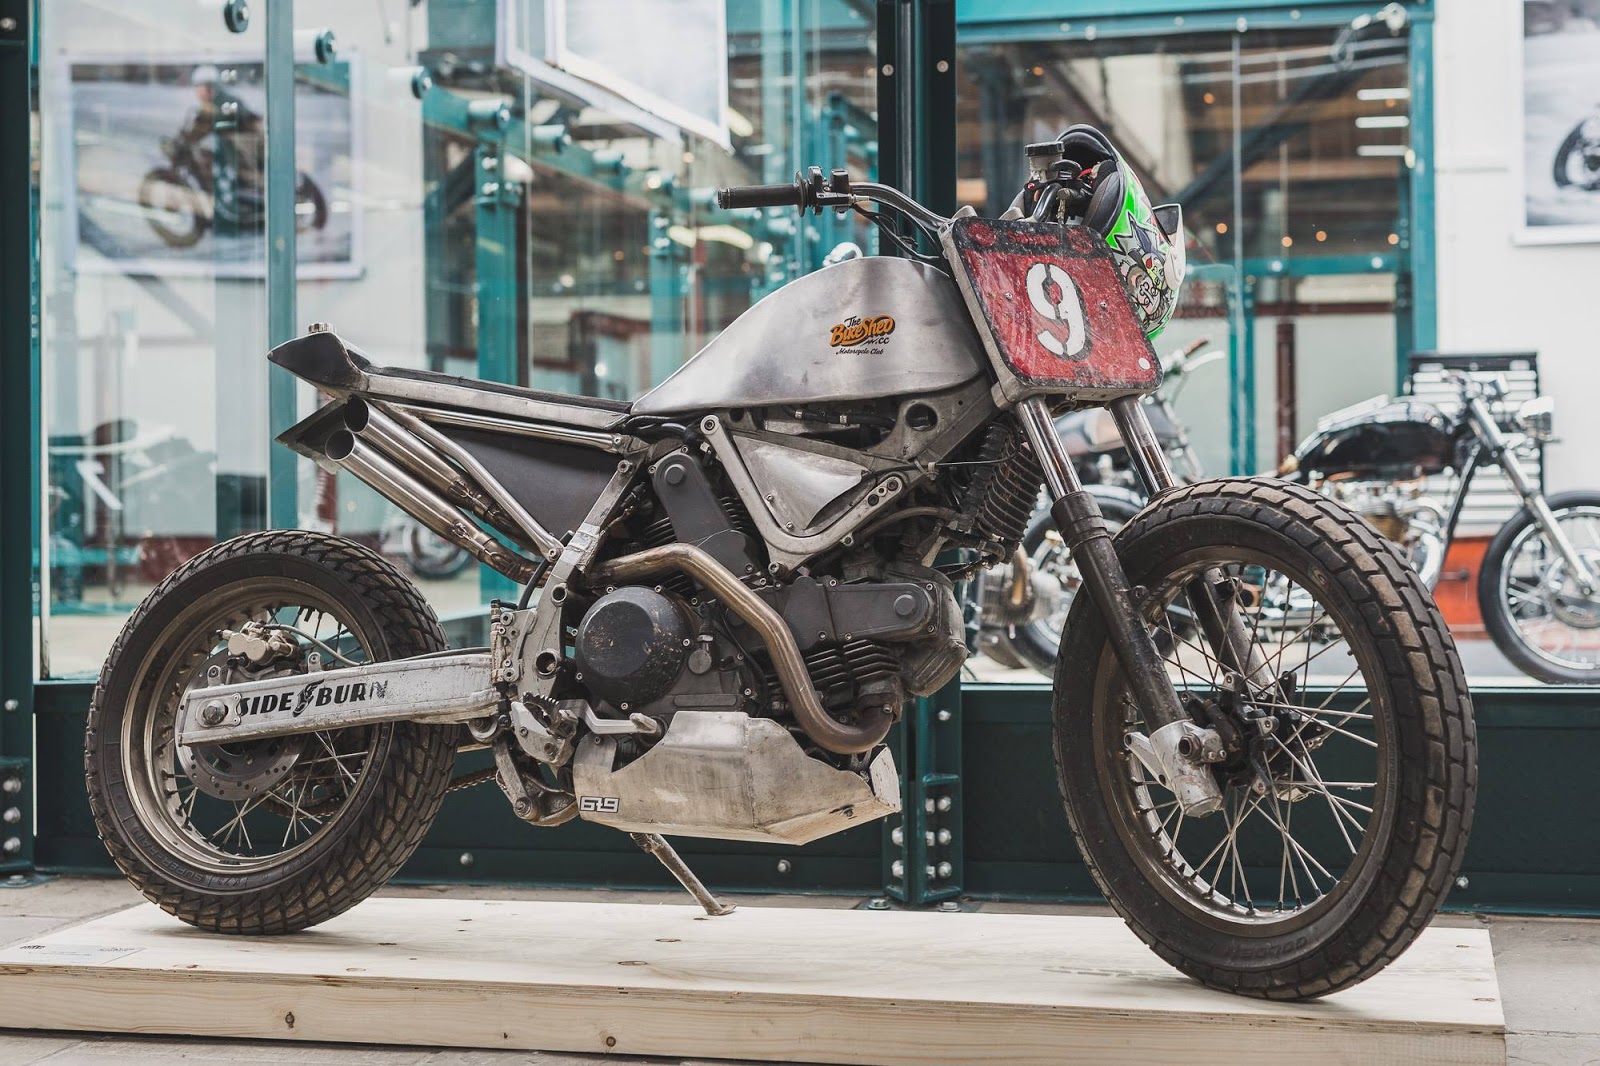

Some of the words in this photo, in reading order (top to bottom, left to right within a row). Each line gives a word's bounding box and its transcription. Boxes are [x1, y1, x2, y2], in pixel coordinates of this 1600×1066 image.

[1026, 262, 1087, 361] 9
[844, 315, 861, 328] The
[836, 348, 869, 356] Motorcycle
